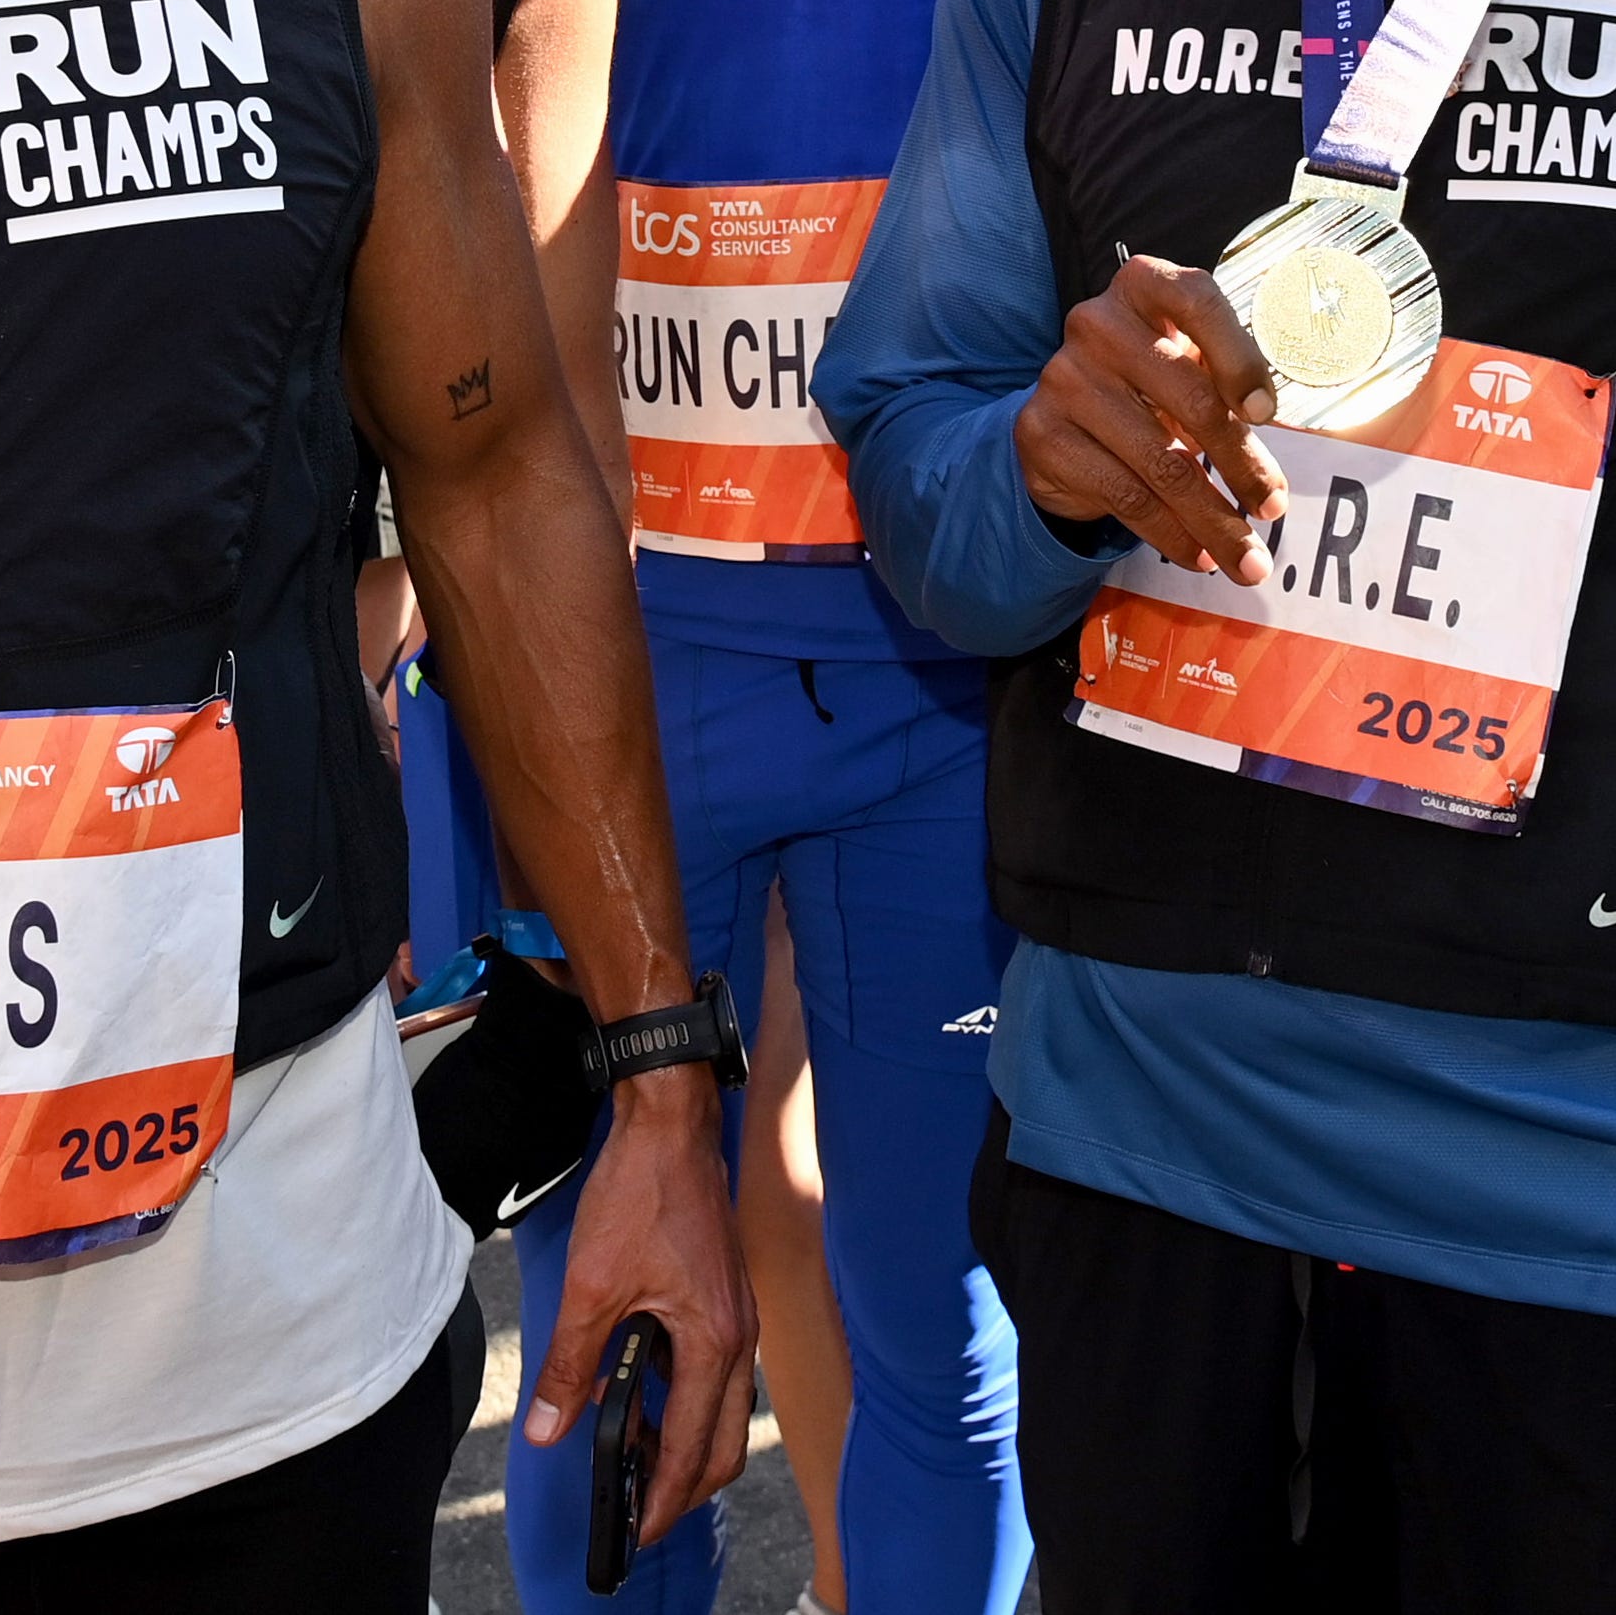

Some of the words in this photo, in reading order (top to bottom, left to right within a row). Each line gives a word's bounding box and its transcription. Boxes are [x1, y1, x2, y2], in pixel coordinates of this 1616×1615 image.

[630, 196, 701, 259] tcs
[709, 201, 765, 217] TATA
[709, 216, 837, 238] CONSULTANCY
[710, 239, 792, 257] SERVICES
[1452, 403, 1533, 442] TATA
[1357, 691, 1508, 762] 2025
[104, 777, 180, 814] TATA
[1420, 796, 1448, 812] CALL
[58, 1103, 200, 1182] 2025
